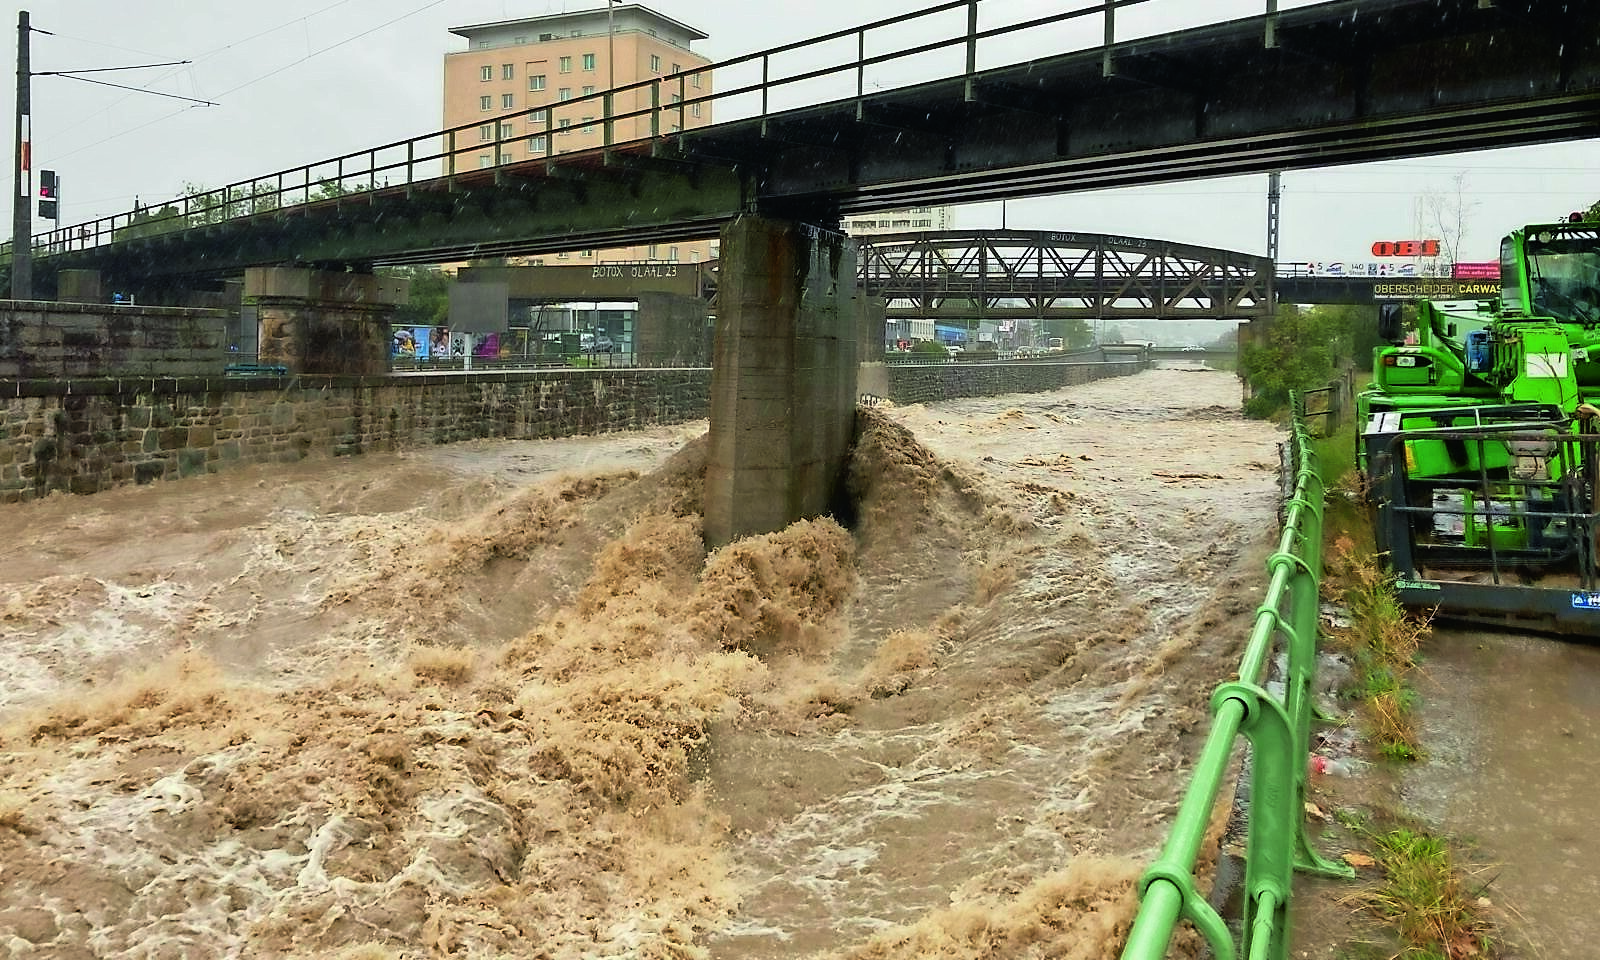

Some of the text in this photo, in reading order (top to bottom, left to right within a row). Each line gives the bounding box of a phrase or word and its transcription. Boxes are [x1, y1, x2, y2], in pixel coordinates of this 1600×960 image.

[1051, 233, 1076, 241] BOTOX
[1317, 262, 1323, 270] 5
[1388, 263, 1395, 272] 5
[592, 266, 624, 278] BOTOX
[665, 266, 677, 277] 23
[1374, 284, 1454, 294] OBERSCHEIDER
